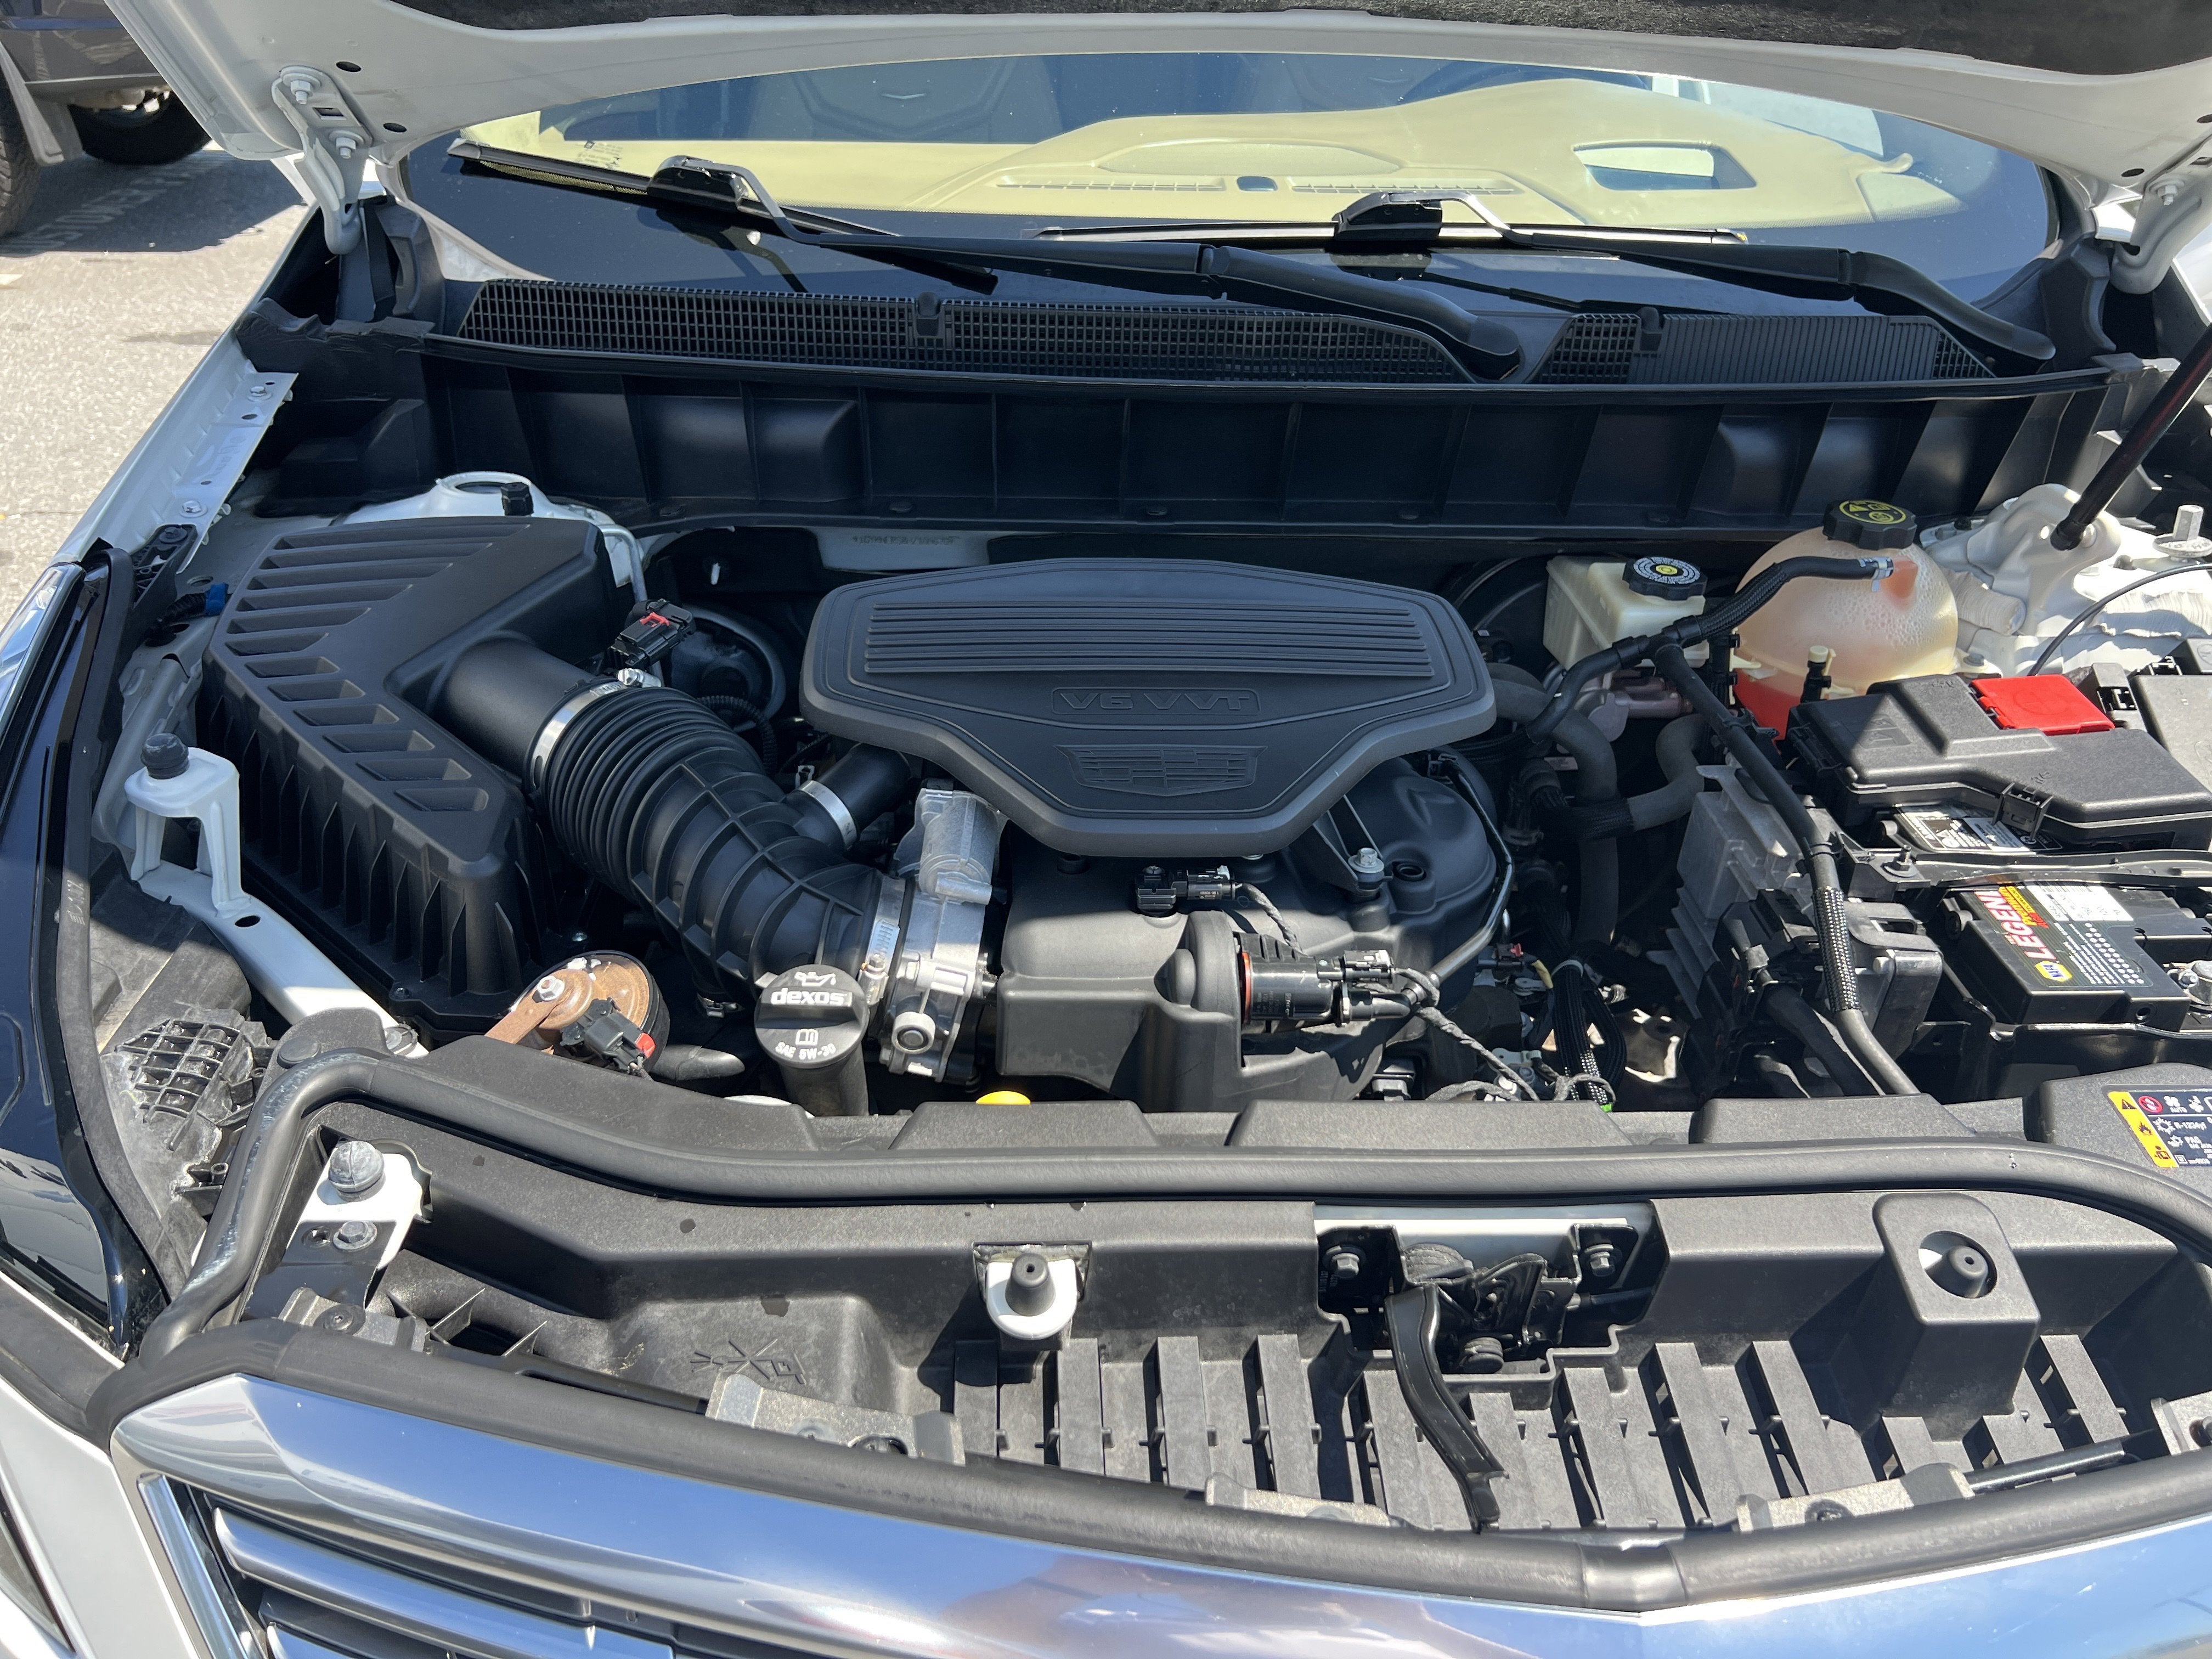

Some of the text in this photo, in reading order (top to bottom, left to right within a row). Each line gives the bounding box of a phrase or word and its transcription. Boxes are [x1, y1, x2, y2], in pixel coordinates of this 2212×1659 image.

[1060, 692, 1250, 710] V6 VVT
[2042, 964, 2064, 978] NAPA
[775, 1041, 836, 1060] SAE 5W-30
